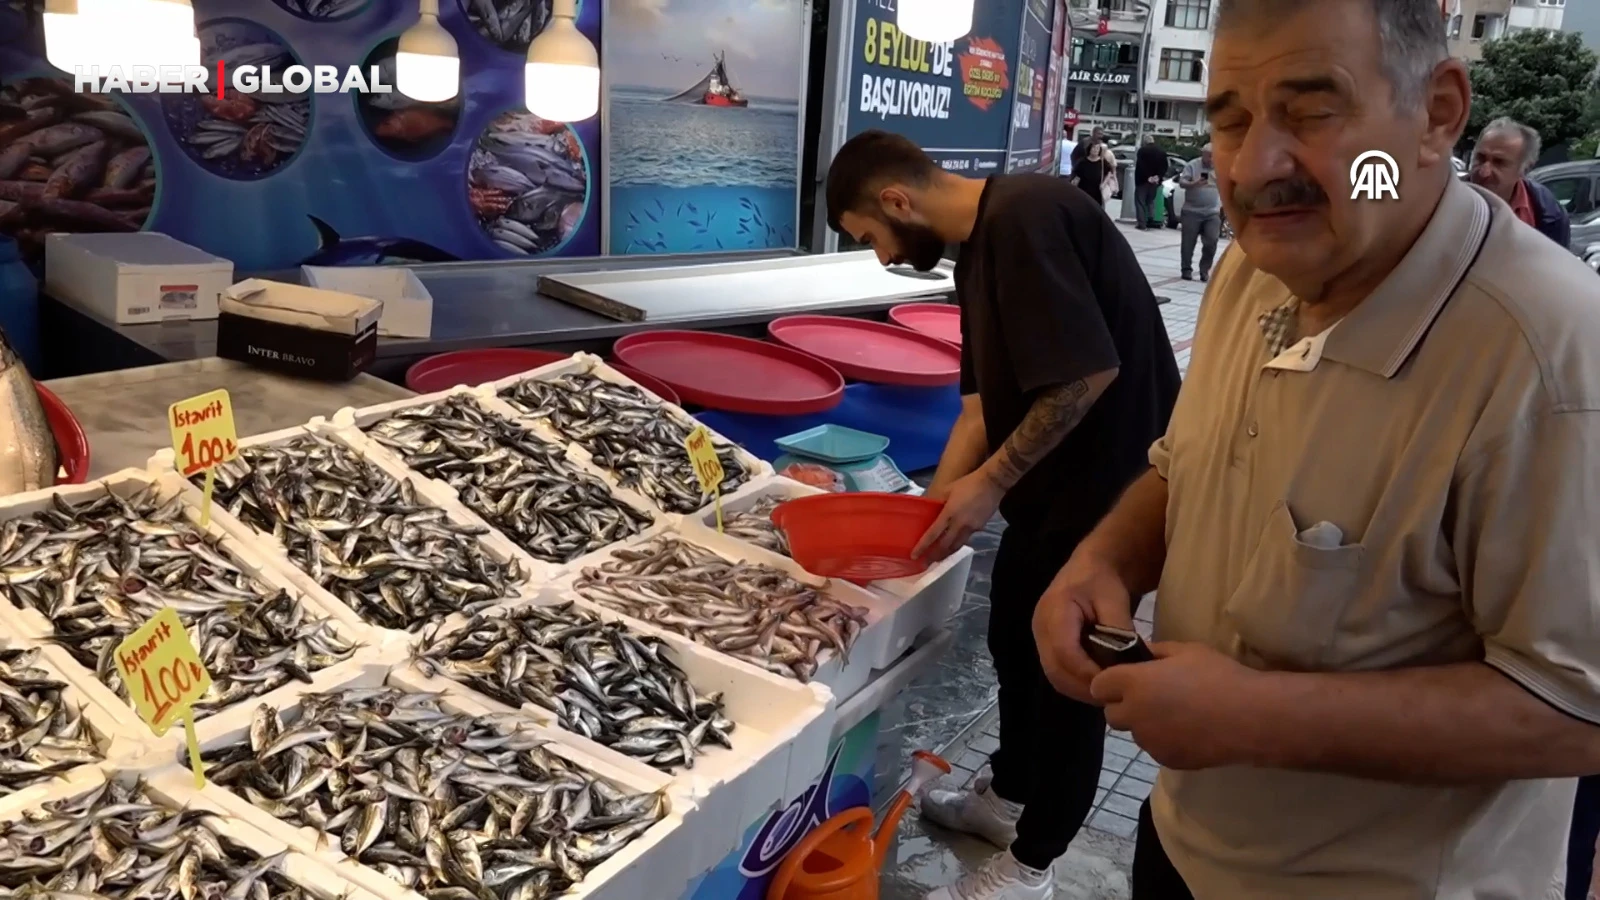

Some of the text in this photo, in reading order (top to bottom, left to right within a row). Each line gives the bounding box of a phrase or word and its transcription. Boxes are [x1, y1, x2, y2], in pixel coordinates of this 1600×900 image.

[864, 17, 878, 63] 8
[860, 73, 952, 121] BAŞLIYORUZ!
[248, 344, 316, 367] INTER BRAVO
